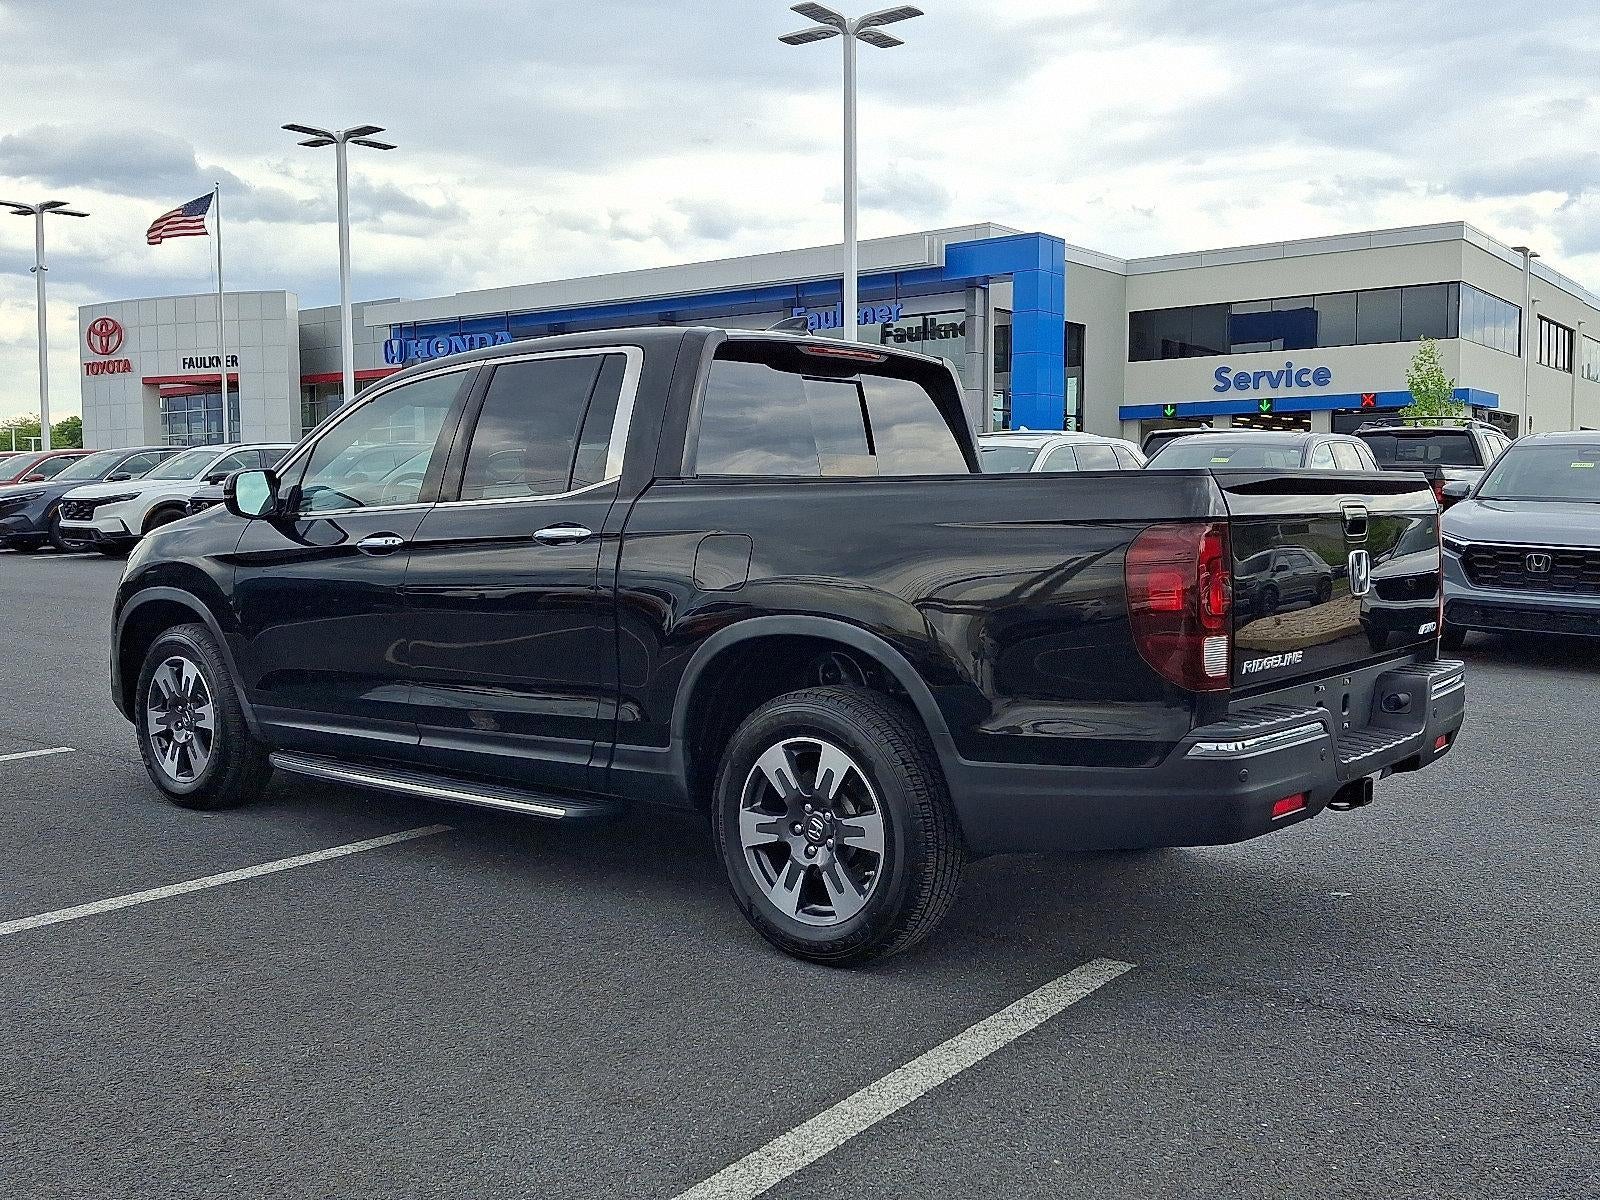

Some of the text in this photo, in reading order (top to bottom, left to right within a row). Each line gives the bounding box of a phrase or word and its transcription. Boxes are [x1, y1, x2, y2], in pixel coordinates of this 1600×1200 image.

[792, 301, 903, 333] aulner
[408, 331, 513, 359] HONDA
[84, 358, 132, 376] TOYOTA
[182, 354, 239, 370] FAULKNER
[1213, 361, 1332, 393] Service
[1241, 650, 1303, 675] RIDGELINE
